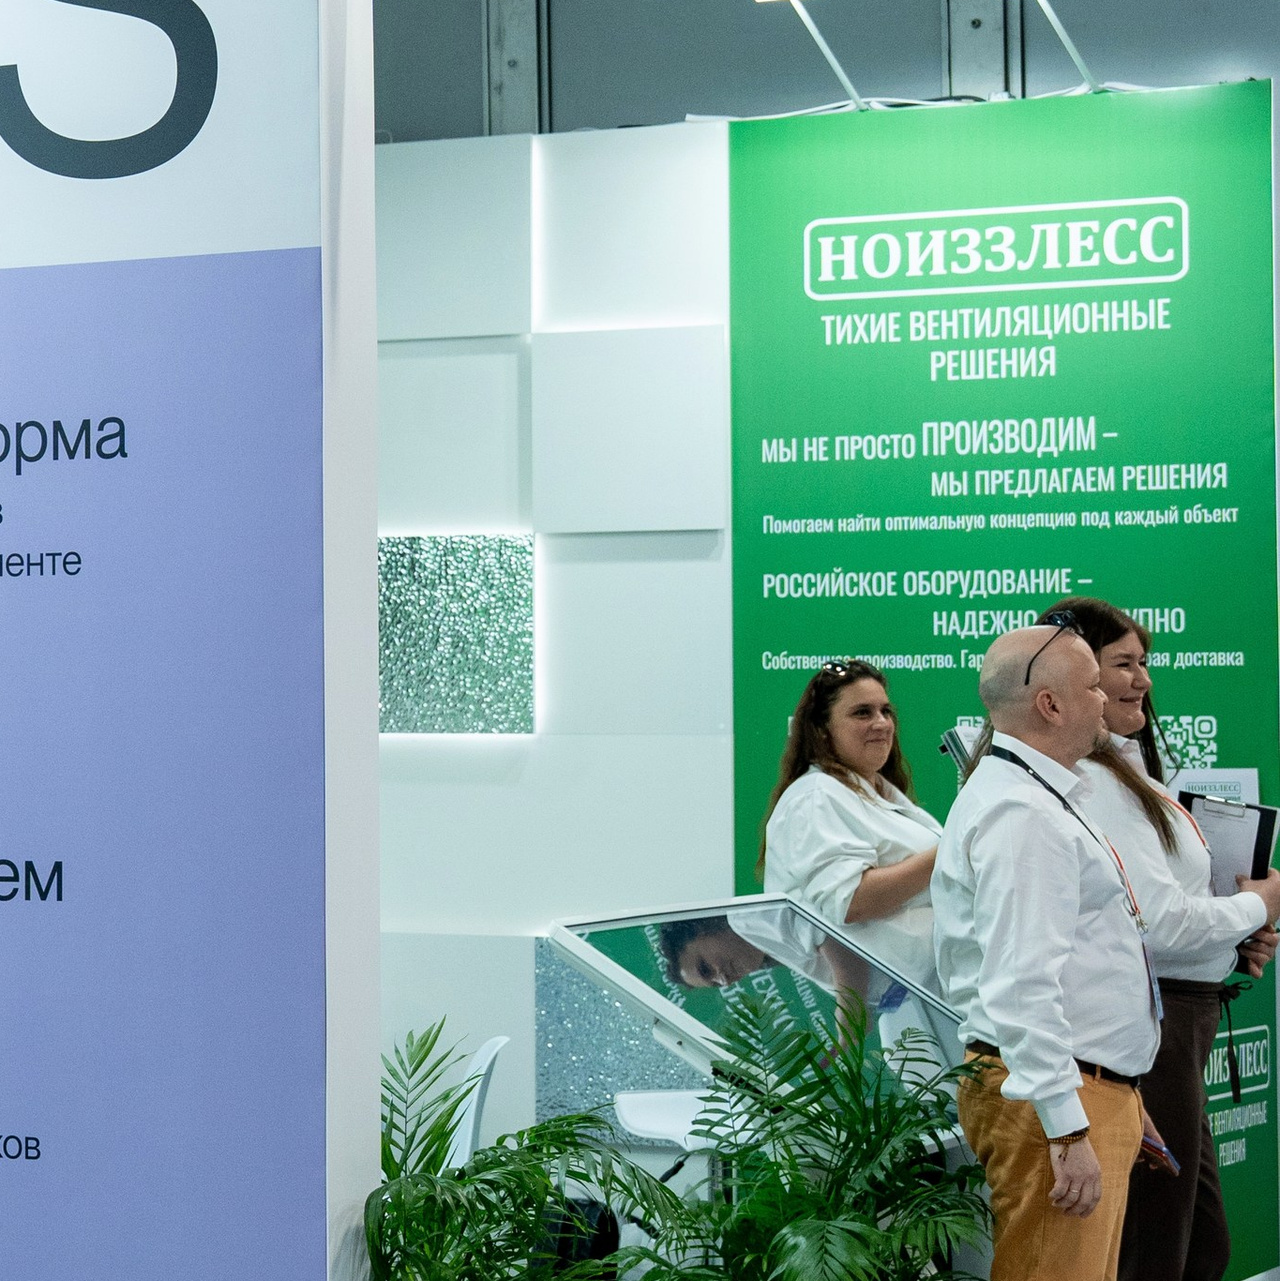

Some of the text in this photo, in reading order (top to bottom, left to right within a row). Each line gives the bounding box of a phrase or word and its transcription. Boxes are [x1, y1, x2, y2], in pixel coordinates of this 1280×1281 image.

[819, 216, 1173, 281] НОИЗЗЛЕСС
[821, 298, 1170, 345] ТИХИЕ ВЕНТИЛЯЦИОННЫЕ
[931, 346, 1056, 381] РЕШЕНИЯ
[762, 439, 797, 462] МЫ
[804, 437, 828, 461] НЕ
[835, 434, 915, 460] ПРОСТО
[923, 416, 1095, 457] ПРОИЗВОДИМ
[932, 463, 1227, 497] МЫ ПРЕДЛАГАЕМ РЕШЕНИЯ
[763, 504, 1238, 533] Помогаем найти оптимальную концепцию под каждый объект
[763, 568, 896, 598] РОССИЙСКОЕ
[904, 569, 1071, 598] ОБОРУДОВАНИЕ
[1174, 651, 1244, 669] доставка
[1204, 1039, 1267, 1086] ОИЗЛЕСС
[1219, 1138, 1246, 1167] РЕШЕНИЯ
